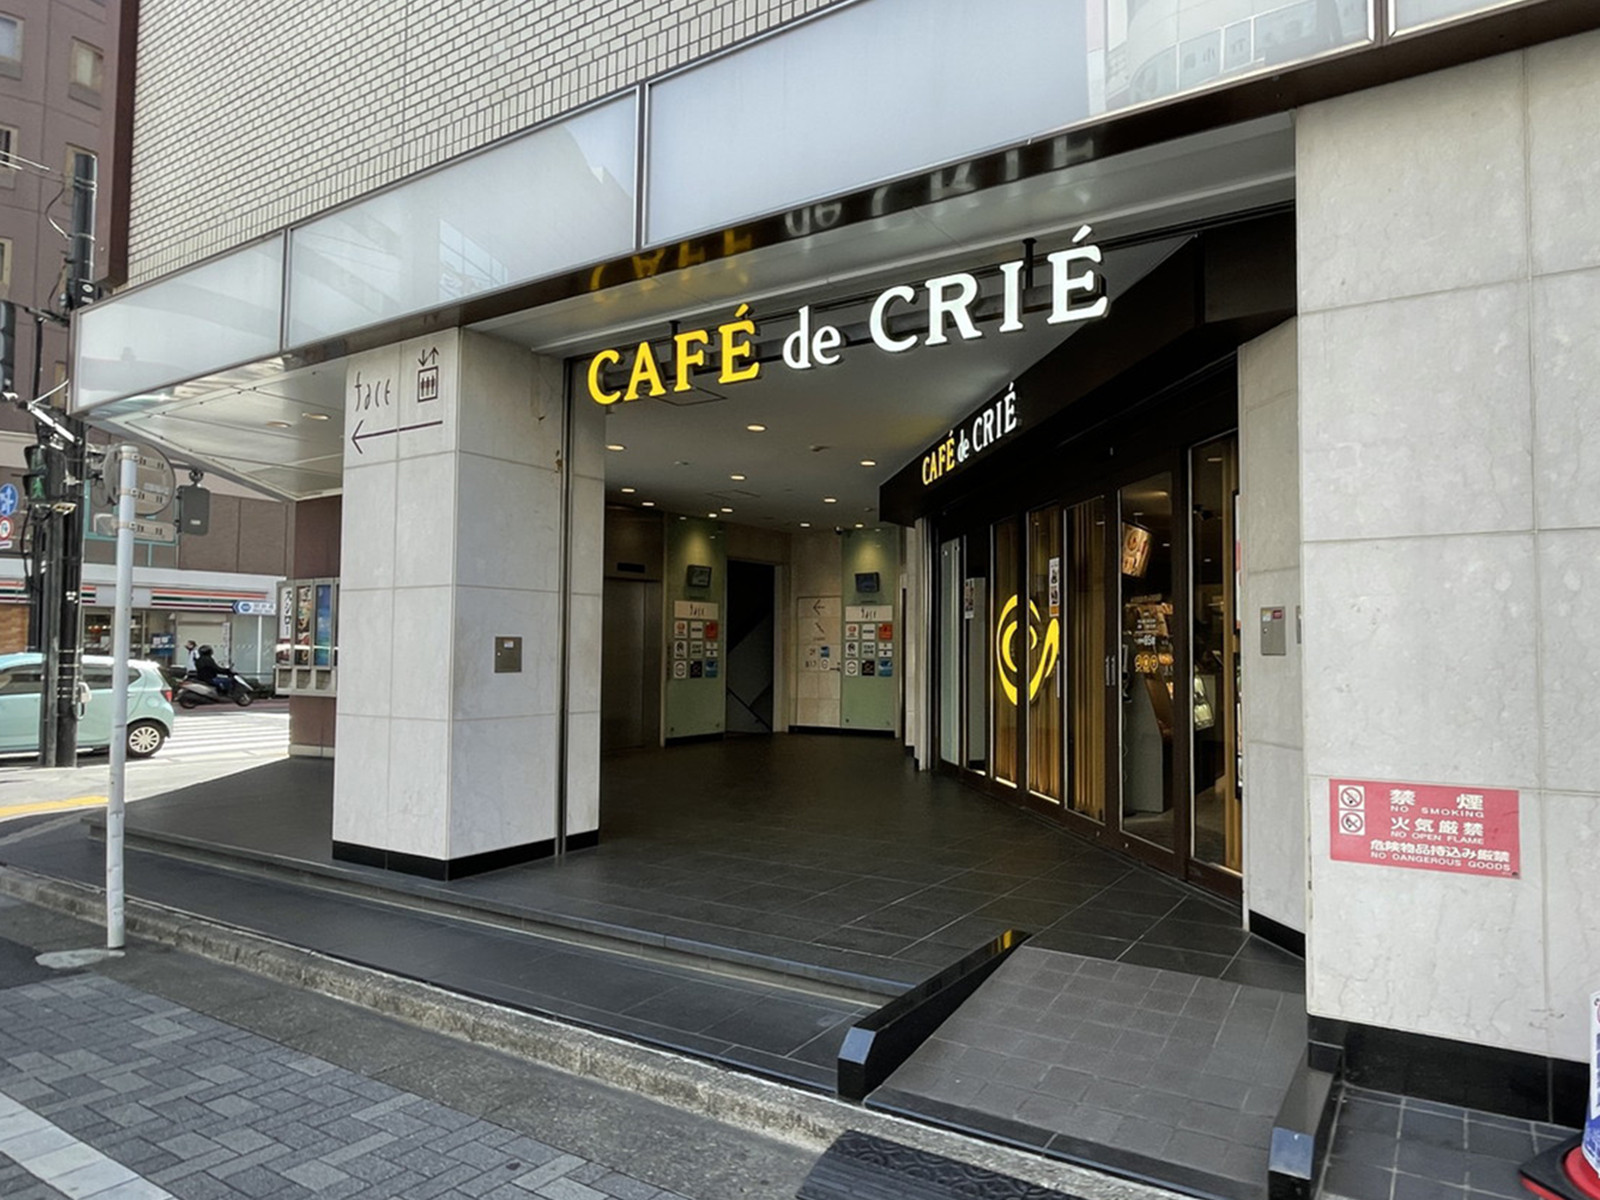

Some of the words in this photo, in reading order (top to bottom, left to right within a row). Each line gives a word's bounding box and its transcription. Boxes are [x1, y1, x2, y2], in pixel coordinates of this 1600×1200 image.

[587, 303, 760, 405] CAFÉ
[782, 306, 842, 370] de
[869, 225, 1109, 353] CRIÉ
[921, 430, 956, 486] CAFÉ
[957, 429, 970, 464] de
[972, 382, 1018, 452] CRIÉ
[1390, 805, 1409, 813] NO
[1421, 807, 1485, 819] SMOKING
[1390, 816, 1484, 837] 火気厳禁
[1390, 830, 1407, 838] NO
[1412, 831, 1442, 841] OPEN
[1447, 835, 1484, 845] FLAME
[1370, 839, 1510, 863] 危険物品持込み厳禁
[1370, 851, 1386, 860] NO
[1392, 854, 1462, 867] DANGEROUS
[1468, 860, 1511, 871] GOODS
